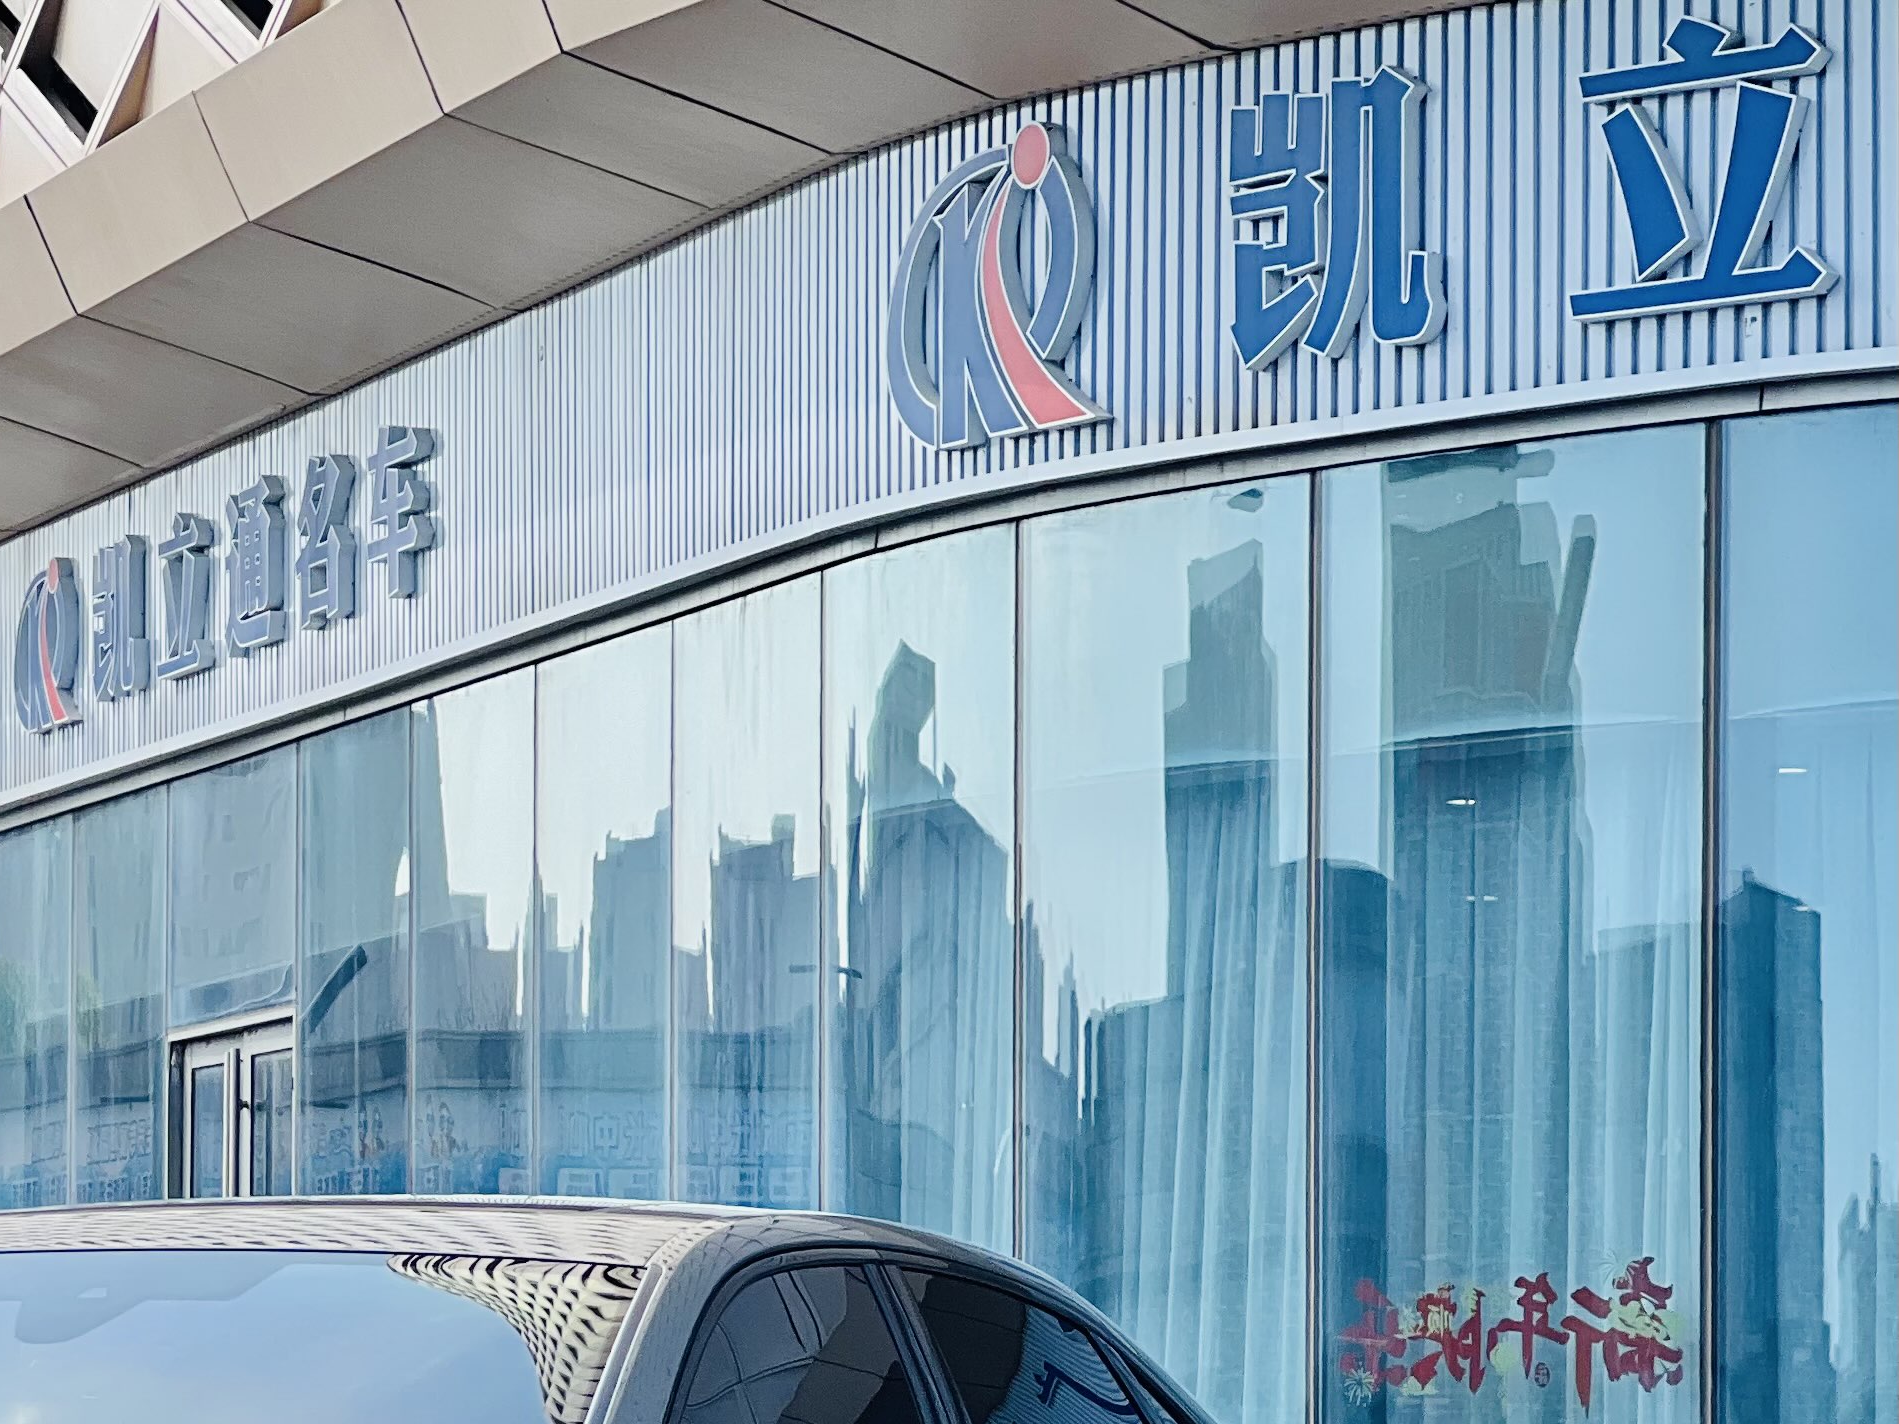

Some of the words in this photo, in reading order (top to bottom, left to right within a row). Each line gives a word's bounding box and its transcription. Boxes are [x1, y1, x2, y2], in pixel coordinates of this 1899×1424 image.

[1227, 14, 1840, 371] 凯立
[90, 425, 438, 702] 凯立通名车
